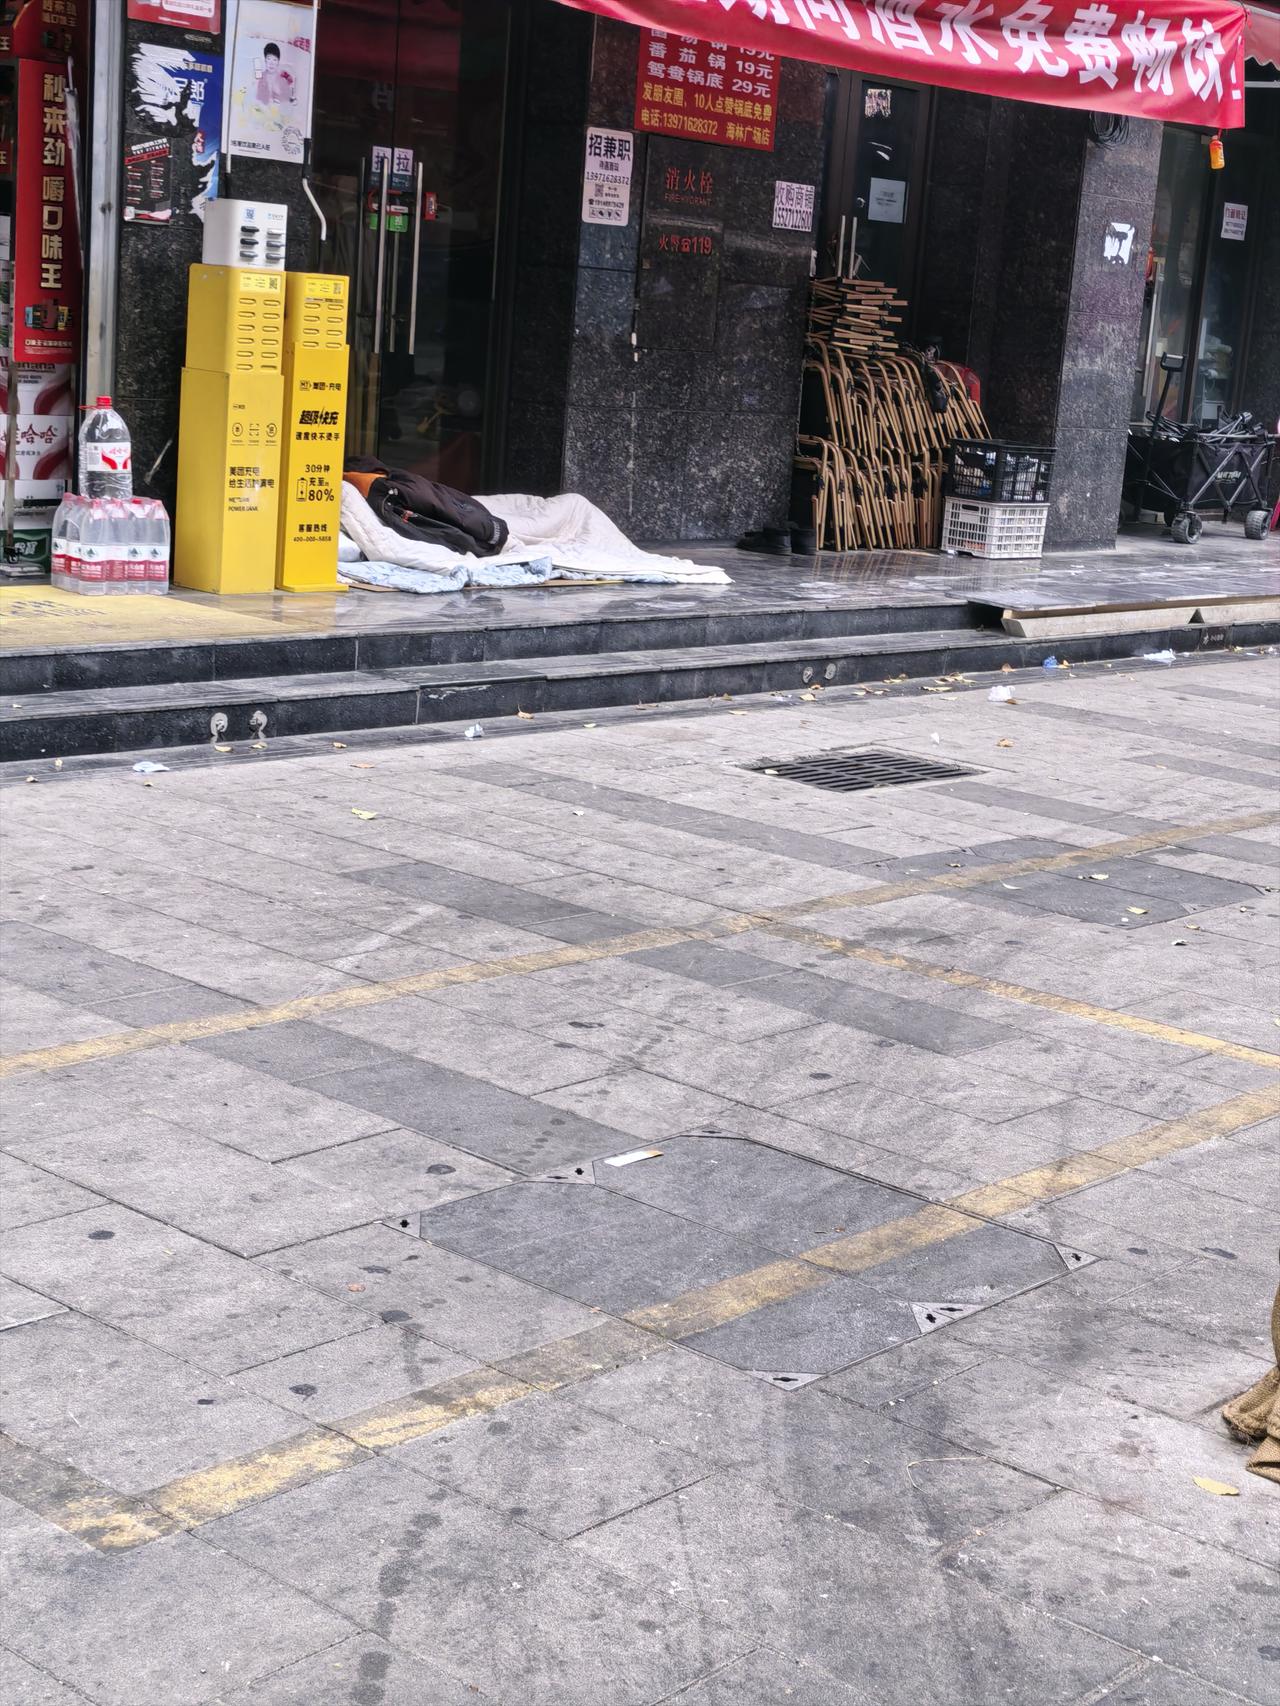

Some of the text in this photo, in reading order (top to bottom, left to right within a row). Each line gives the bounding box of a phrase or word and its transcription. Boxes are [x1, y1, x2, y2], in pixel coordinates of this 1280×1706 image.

[647, 61, 771, 98] 鸳鸯锅底 29元
[588, 133, 631, 161] 招兼职
[726, 122, 771, 146] 海林广场店
[396, 152, 410, 173] 拉
[41, 73, 66, 289] 秒来劲 嚼口味王
[666, 167, 713, 195] 消火栓
[775, 181, 814, 210] 收购商铺
[299, 408, 340, 427] 超级快充
[305, 464, 331, 473] 30分钟
[308, 488, 335, 502] 80%
